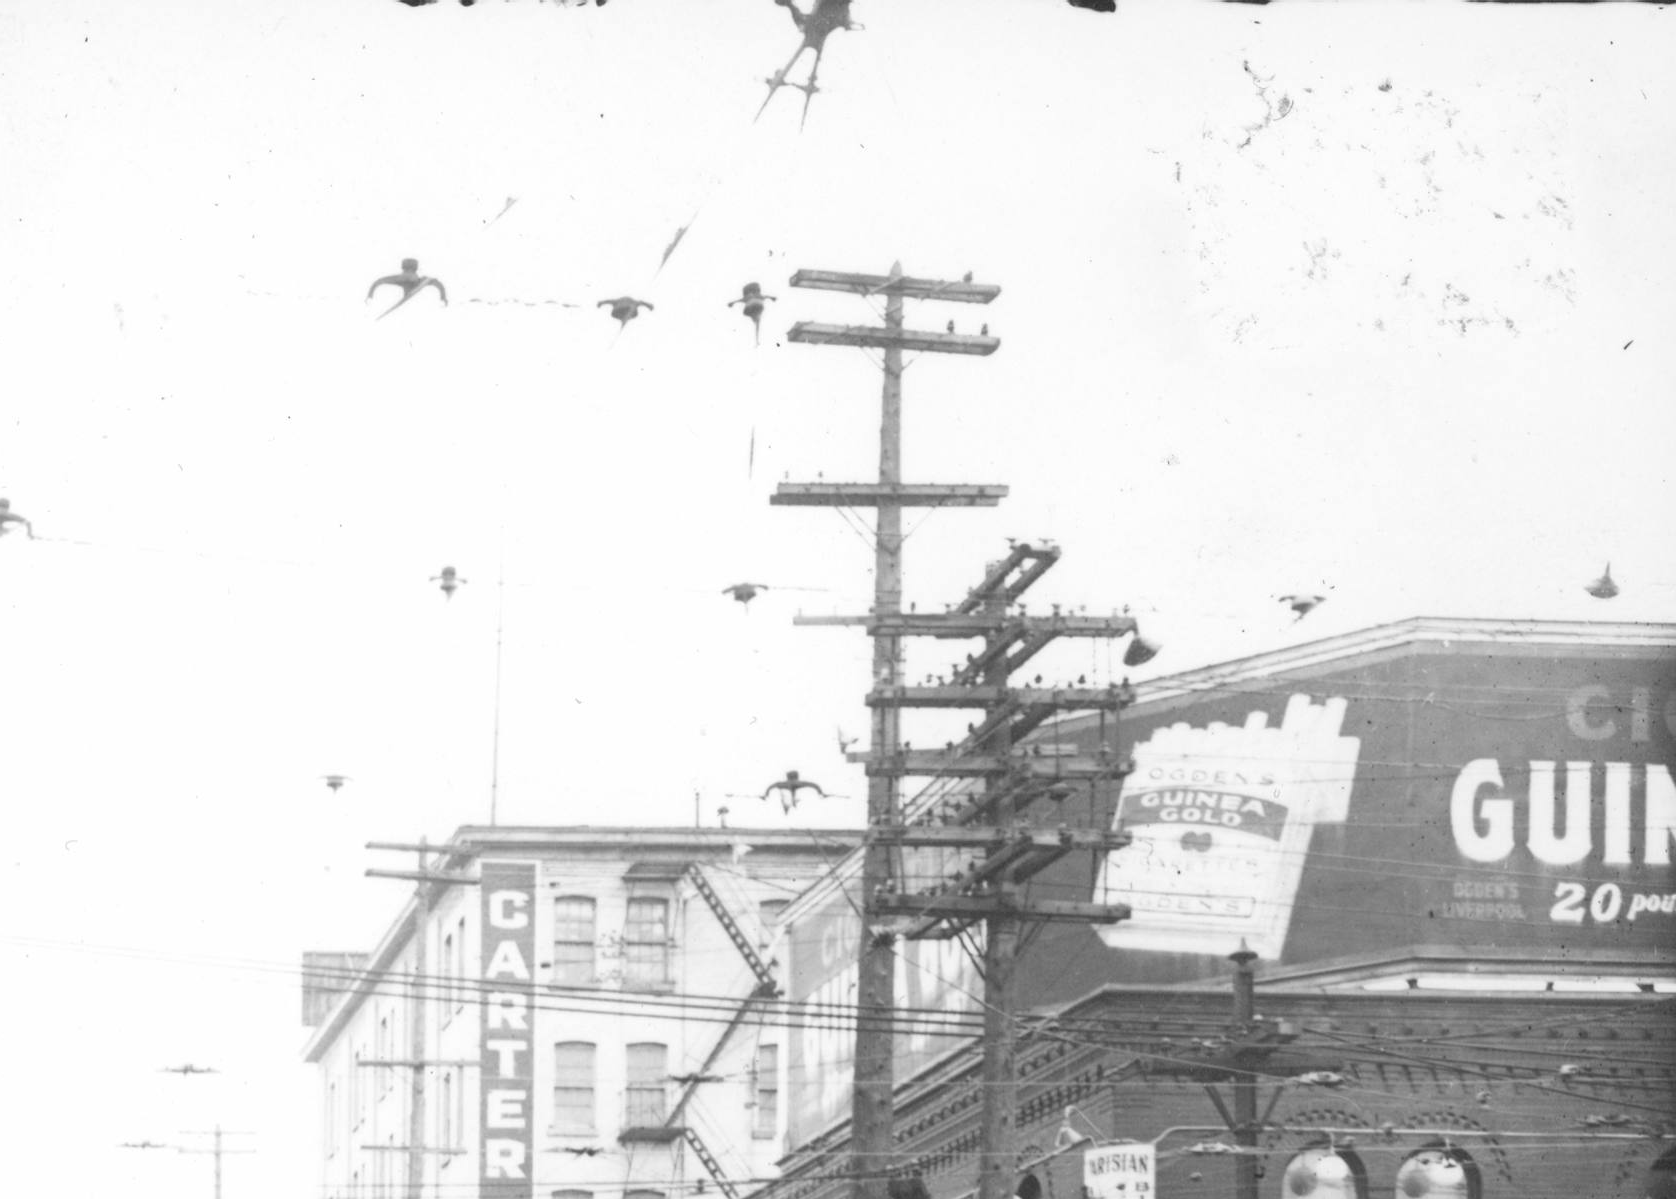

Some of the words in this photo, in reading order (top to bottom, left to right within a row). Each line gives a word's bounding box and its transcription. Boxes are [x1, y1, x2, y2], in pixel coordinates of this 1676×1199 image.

[1567, 684, 1676, 742] CI
[1140, 791, 1266, 817] GUINEA
[1159, 807, 1242, 827] GOLD
[1550, 881, 1622, 923] 20
[486, 888, 530, 1180] CARTER
